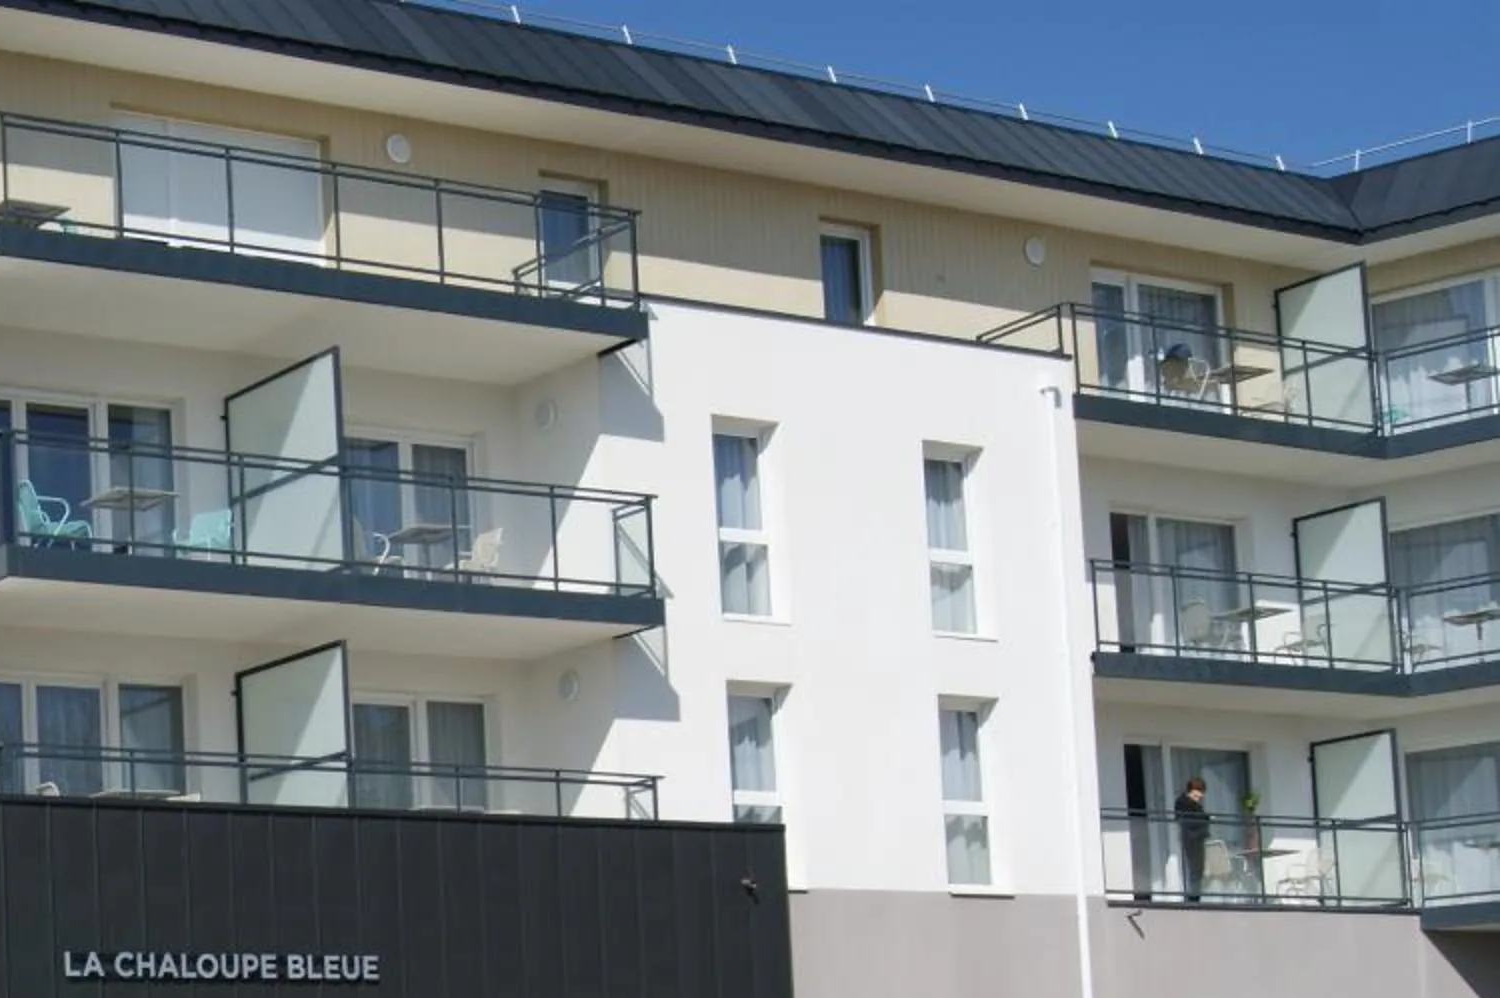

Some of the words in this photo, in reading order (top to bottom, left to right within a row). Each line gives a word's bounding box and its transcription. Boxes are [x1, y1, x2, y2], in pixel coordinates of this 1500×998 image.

[64, 951, 105, 977] LA
[114, 951, 277, 979] CHALOUPE
[286, 954, 380, 980] BLEUE
